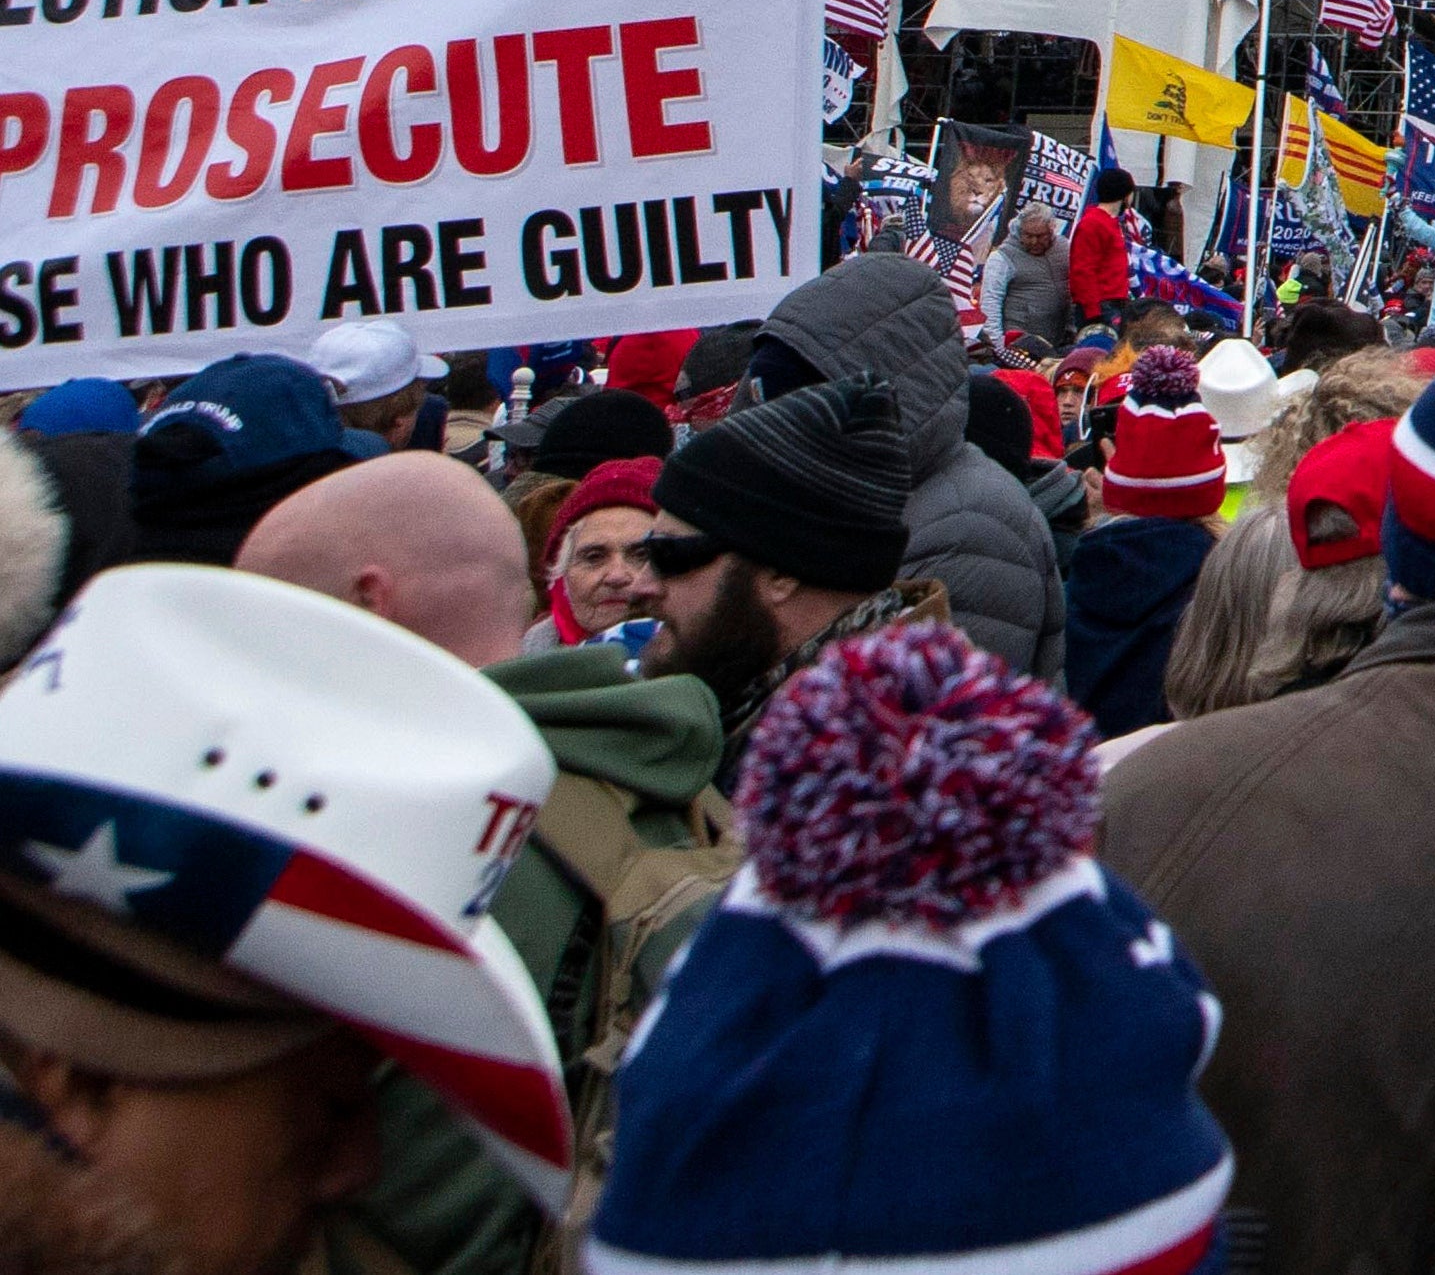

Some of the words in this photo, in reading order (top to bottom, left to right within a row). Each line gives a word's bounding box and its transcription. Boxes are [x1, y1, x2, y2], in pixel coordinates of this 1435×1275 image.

[107, 235, 291, 338] WHO
[321, 217, 491, 321] ARE
[522, 187, 794, 301] GUILTY
